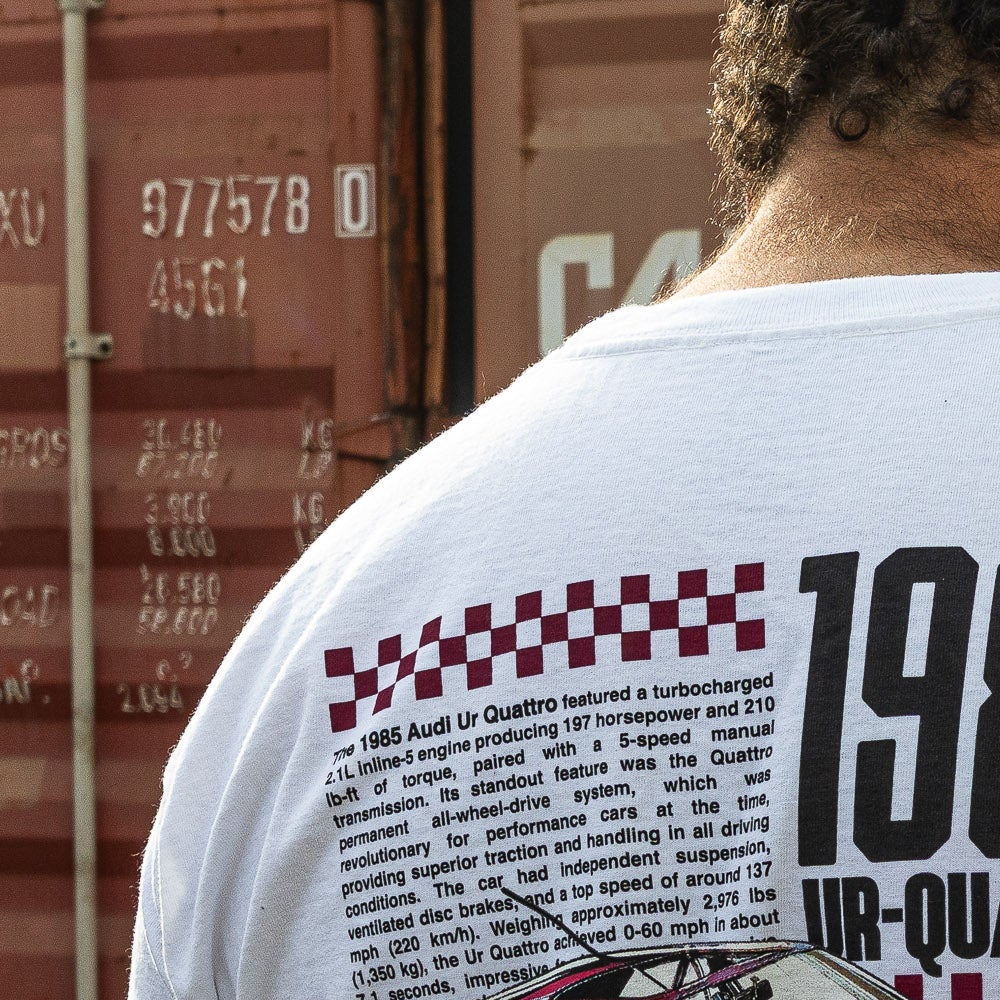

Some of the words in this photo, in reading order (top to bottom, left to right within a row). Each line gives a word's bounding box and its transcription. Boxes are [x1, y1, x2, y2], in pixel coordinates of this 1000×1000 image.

[141, 173, 311, 239] 977578
[341, 168, 370, 235] 0
[148, 256, 248, 320] 45G1
[325, 766, 355, 786] 2.1L
[358, 750, 414, 776] inline-5
[418, 738, 471, 762] engine
[475, 722, 559, 753] producing
[563, 714, 591, 733] 197
[596, 706, 701, 728] horsepower
[706, 701, 739, 719] and
[744, 696, 775, 715] 210
[333, 743, 355, 766] The
[360, 726, 402, 752] 1985
[408, 716, 451, 742] Audi
[457, 711, 479, 731] Ur
[484, 697, 558, 724] Quattro
[563, 686, 631, 710] featured
[637, 688, 648, 700] a
[653, 672, 774, 700] turbocharged
[326, 786, 360, 808] lb-ft
[374, 778, 388, 796] of
[403, 767, 457, 789] torque,
[473, 750, 526, 777] paired
[543, 741, 576, 760] with
[593, 739, 602, 752] a
[619, 729, 691, 751] 5-speed
[711, 720, 775, 742] manual
[333, 794, 429, 828] transmission.
[440, 787, 460, 803] Its
[471, 771, 544, 797] standout
[554, 761, 608, 782] feature
[620, 757, 657, 771] was
[669, 753, 697, 769] the
[710, 746, 773, 766] Quattro
[339, 820, 410, 852] permanent
[432, 795, 551, 829] all-wheel-drive
[573, 782, 636, 806] system,
[663, 775, 718, 793] which
[744, 768, 771, 786] was
[341, 841, 431, 873] revolutionary
[447, 832, 470, 848] for
[486, 813, 587, 845] performance
[600, 806, 638, 822] cars
[656, 801, 674, 818] at
[691, 799, 720, 815] the
[738, 793, 770, 812] time,
[341, 868, 406, 899] providing
[411, 853, 478, 880] superior
[484, 843, 549, 866] traction
[554, 835, 582, 855] and
[587, 825, 661, 848] handling
[668, 824, 686, 841] in
[693, 822, 714, 839] all
[721, 815, 770, 838] driving
[345, 891, 421, 919] conditions.
[433, 882, 465, 899] The
[478, 875, 504, 892] car
[517, 865, 549, 884] had
[560, 850, 661, 878] independent
[676, 840, 771, 866] suspension,
[348, 912, 415, 940] ventilated
[419, 907, 454, 926] disc
[459, 895, 519, 920] brakes,
[523, 888, 555, 907] and
[560, 888, 568, 901] a
[572, 884, 594, 901] top
[599, 874, 653, 897] speed
[661, 872, 679, 889] of
[686, 867, 741, 888] around
[747, 861, 773, 879] 137
[350, 944, 379, 966] mph
[388, 936, 420, 959] (220
[430, 926, 481, 948] km/h).
[489, 913, 563, 938] Weighing
[572, 896, 691, 926] approximately
[703, 891, 739, 913] 2,976
[749, 887, 777, 903] lbs
[352, 964, 396, 990] (1,350
[400, 958, 429, 980] kg),
[433, 954, 460, 971] the
[464, 949, 484, 966] Ur
[490, 940, 549, 962] Quattro
[554, 926, 616, 951] achieved
[623, 922, 663, 940] 0-60
[670, 919, 709, 940] mph
[714, 916, 726, 933] in
[730, 909, 780, 930] about
[464, 964, 549, 990] impressive
